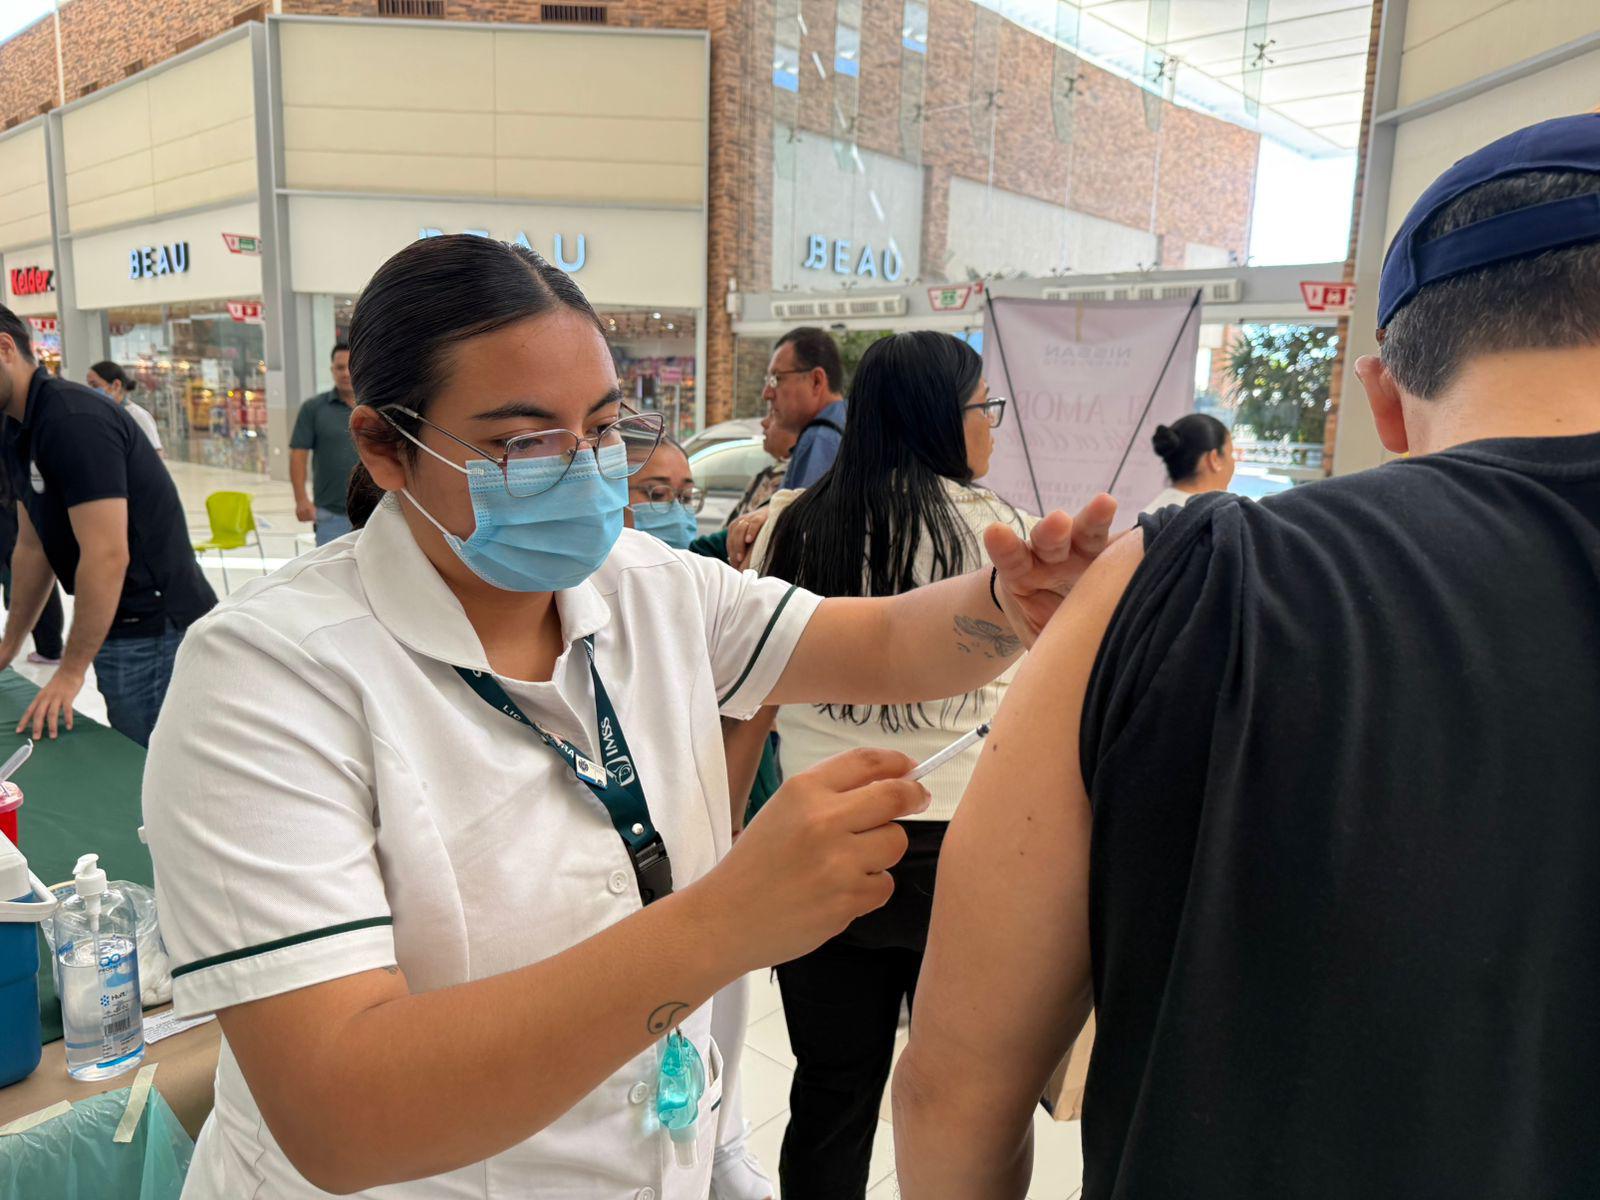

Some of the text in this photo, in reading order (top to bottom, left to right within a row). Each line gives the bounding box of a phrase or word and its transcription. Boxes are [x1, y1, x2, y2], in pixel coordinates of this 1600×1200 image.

[128, 240, 190, 279] BEAU
[803, 233, 902, 282] BEAU
[600, 716, 619, 757] IMSS
